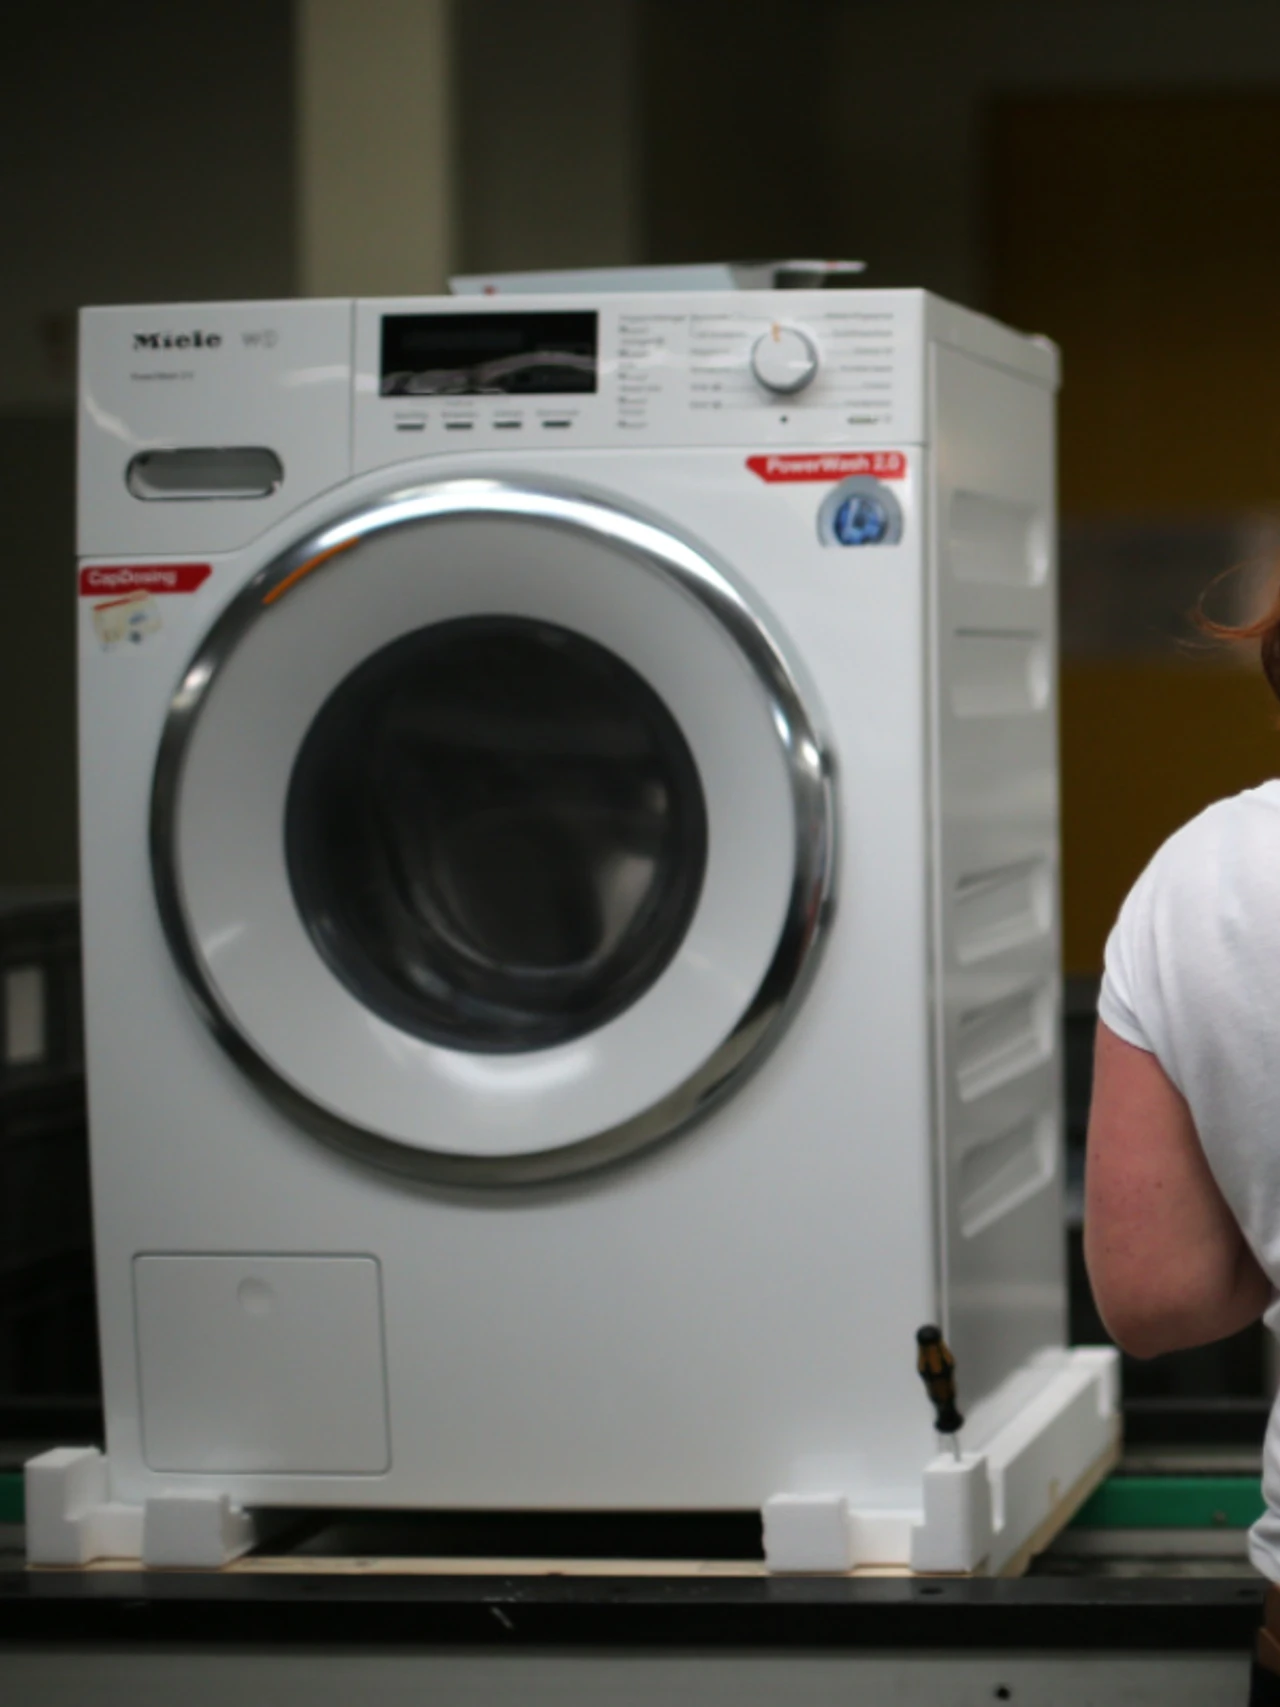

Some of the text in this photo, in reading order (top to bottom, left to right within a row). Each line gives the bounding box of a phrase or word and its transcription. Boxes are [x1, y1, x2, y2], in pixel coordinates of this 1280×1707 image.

[132, 329, 222, 350] Miele
[766, 455, 870, 474] PowerWash
[87, 568, 177, 588] CapDosing
